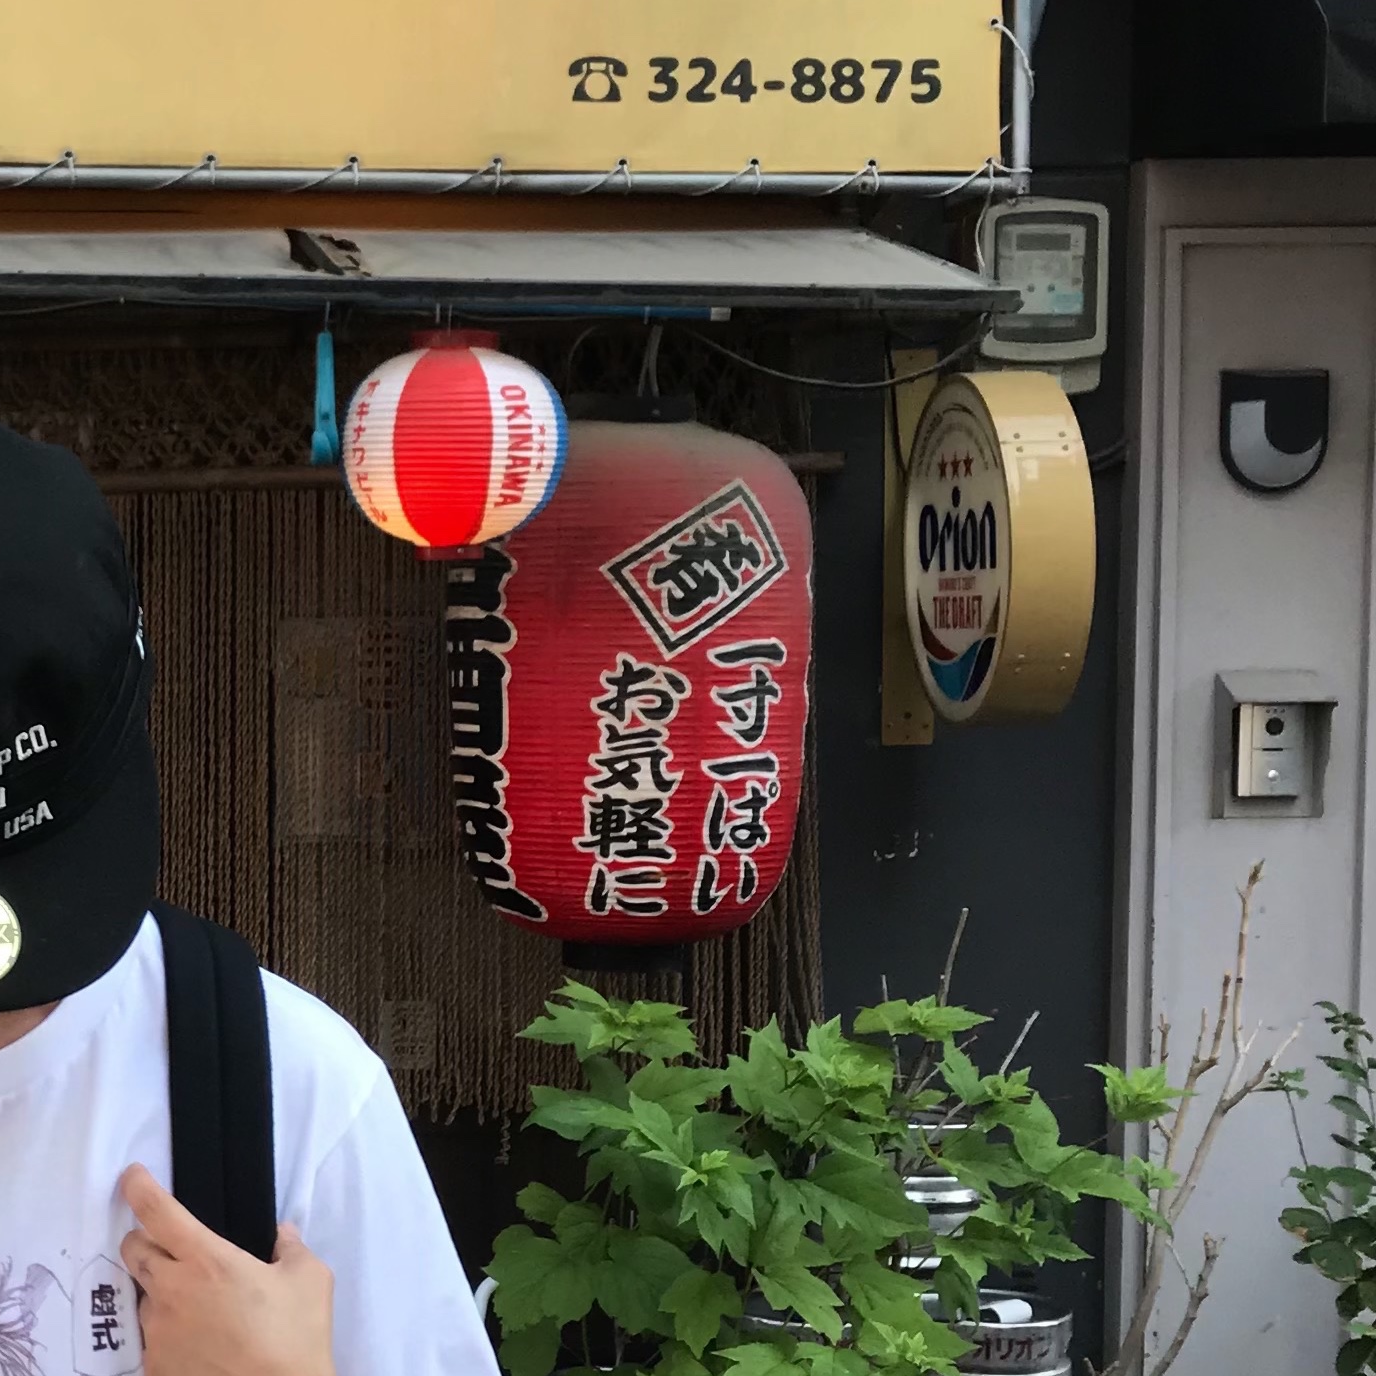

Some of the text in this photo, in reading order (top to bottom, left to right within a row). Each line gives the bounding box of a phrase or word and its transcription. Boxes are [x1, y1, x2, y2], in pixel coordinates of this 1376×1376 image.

[648, 57, 942, 104] 324-8875
[495, 384, 533, 508] OKINAWA
[918, 485, 997, 573] Orion
[15, 724, 58, 761] CO.
[575, 653, 689, 915] お気軽に
[692, 638, 787, 916] 一寸一ぱい
[3, 801, 53, 839] USA
